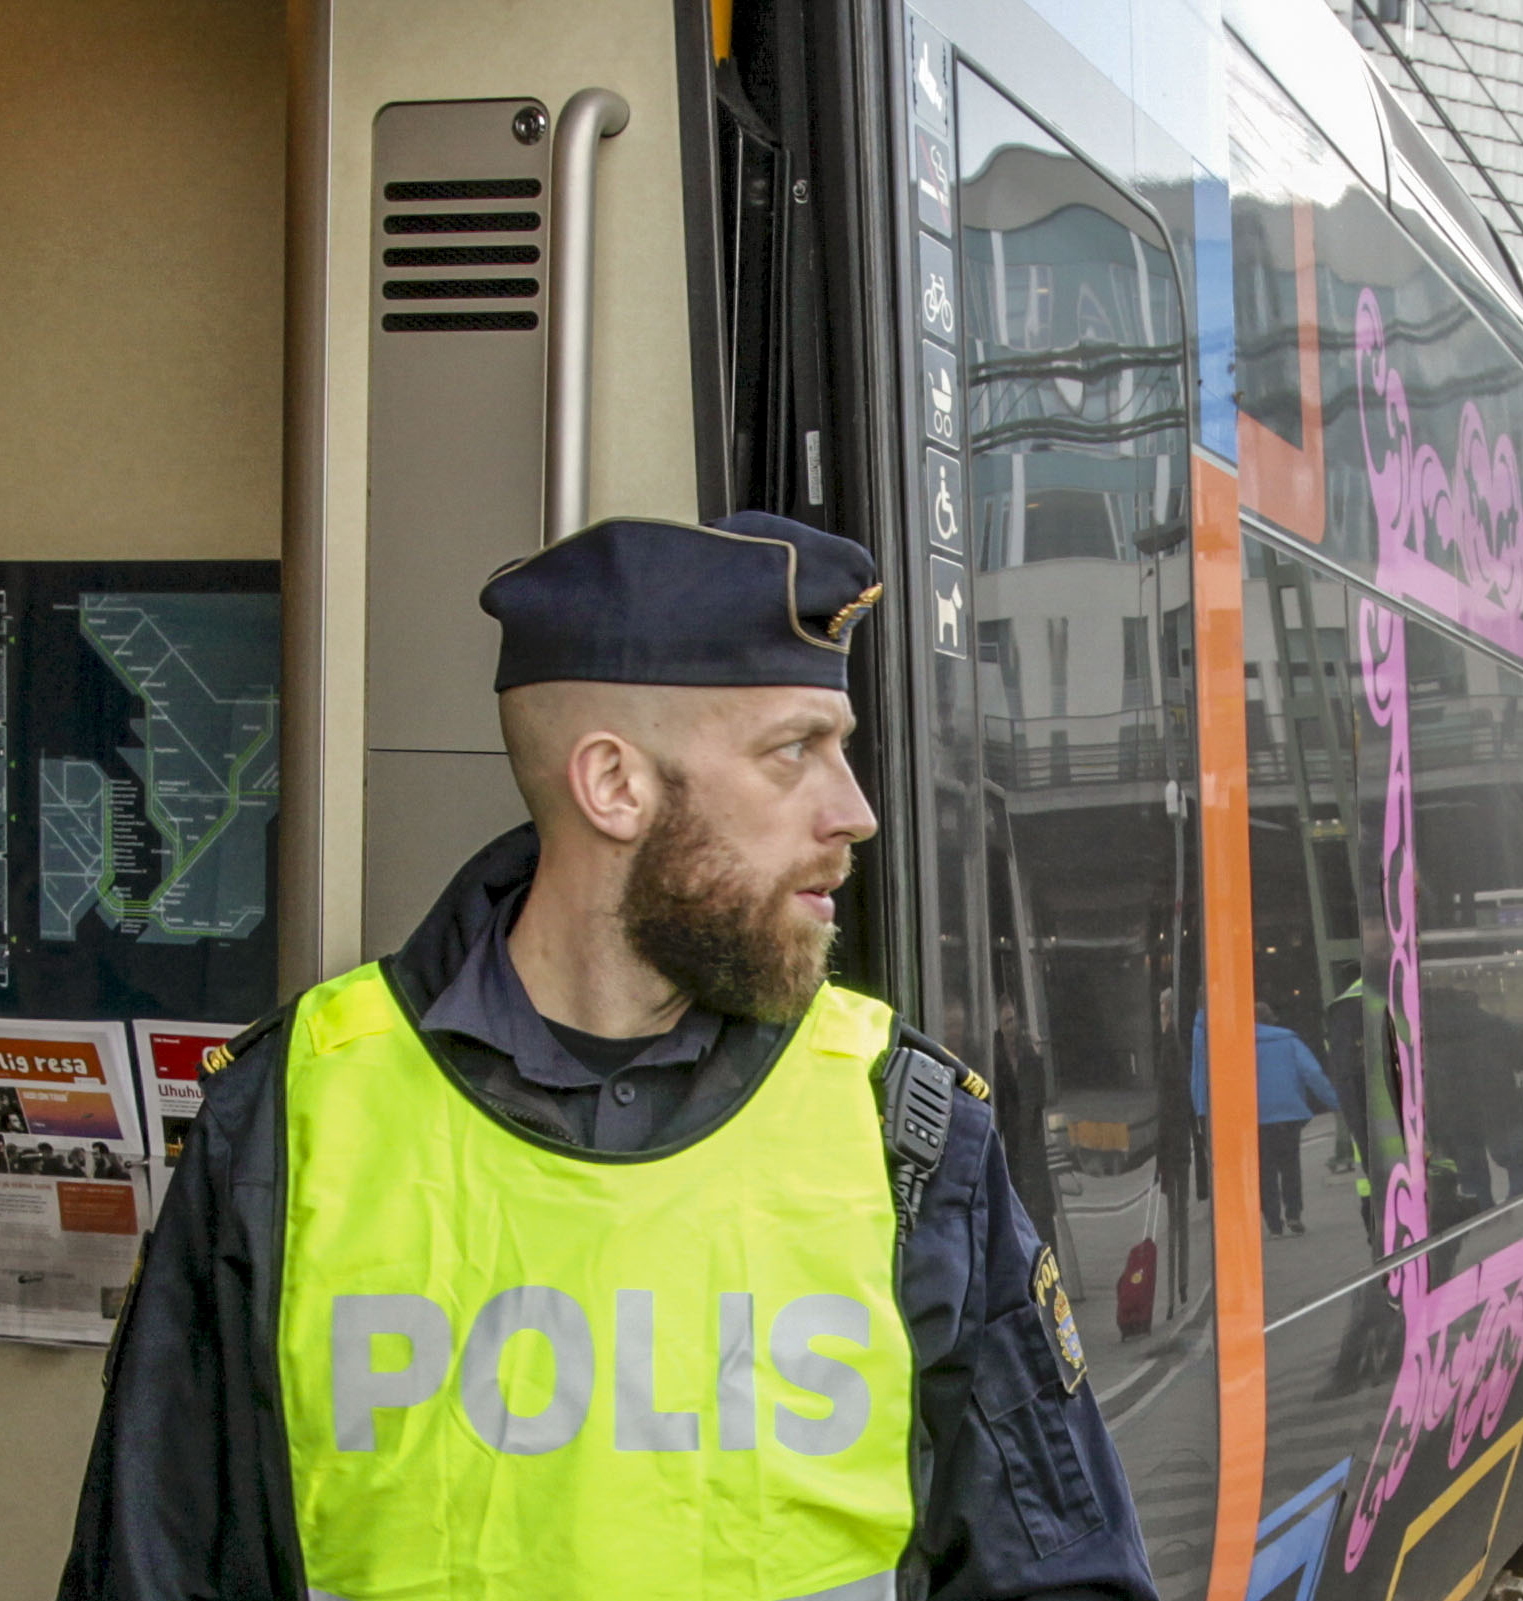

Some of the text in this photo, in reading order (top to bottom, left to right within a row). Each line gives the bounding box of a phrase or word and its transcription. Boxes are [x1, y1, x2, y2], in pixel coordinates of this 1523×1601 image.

[35, 1056, 88, 1075] resa
[1036, 1253, 1060, 1307] POL
[332, 1286, 871, 1457] POLIS
